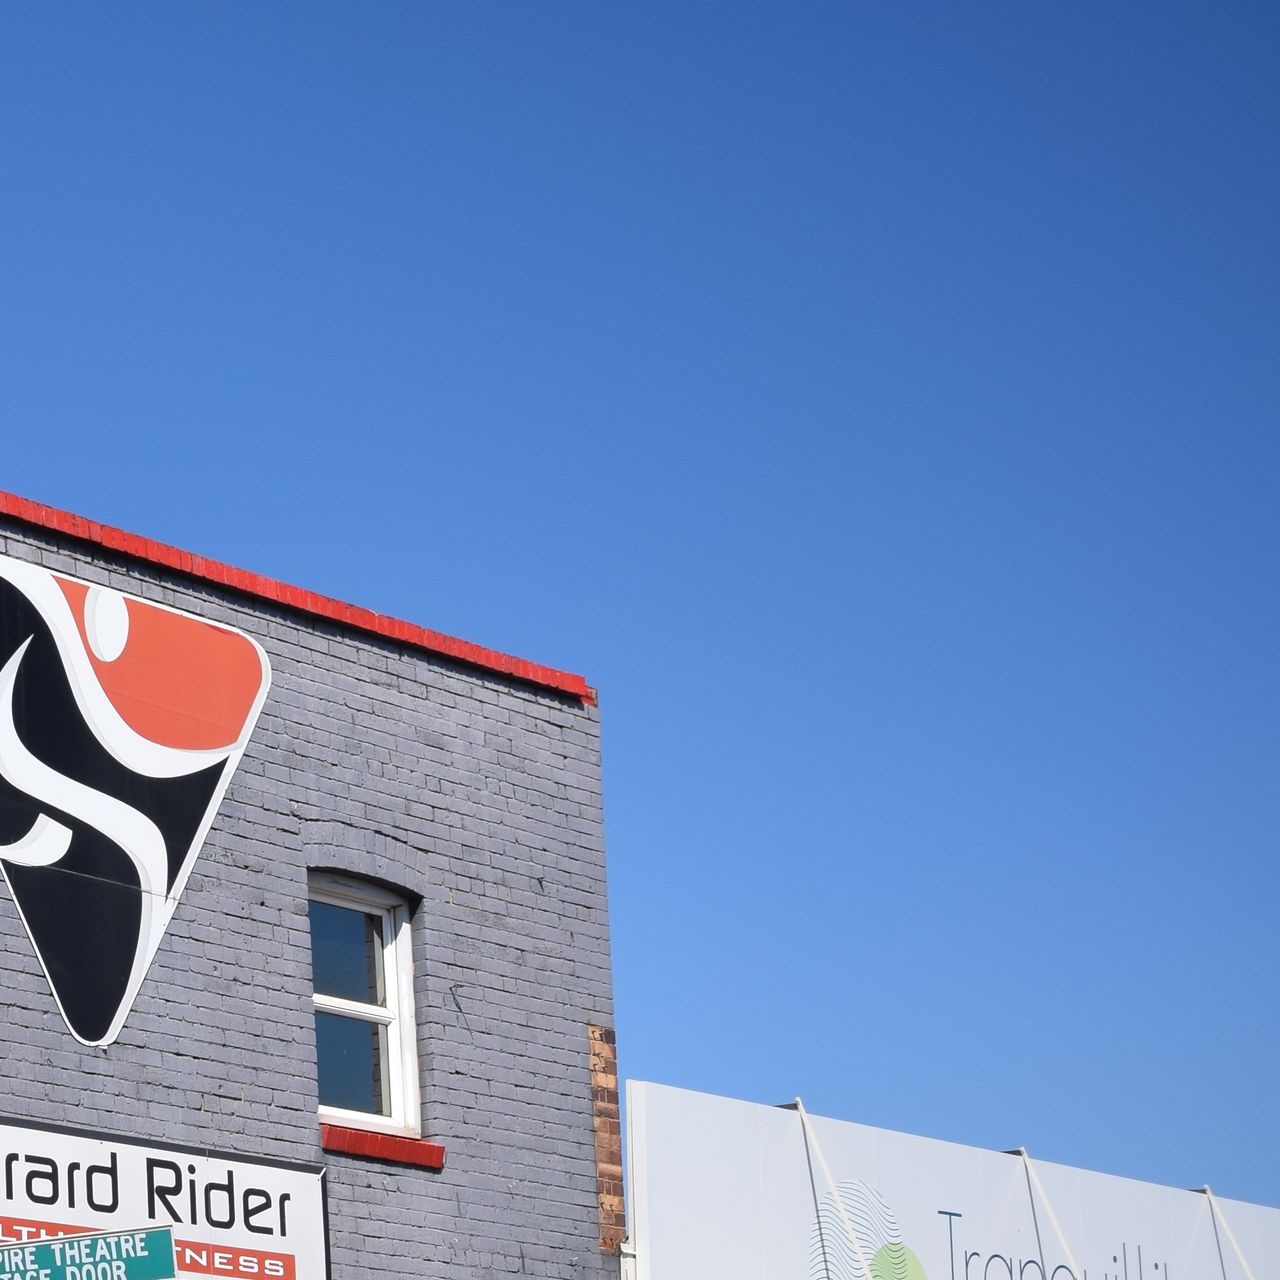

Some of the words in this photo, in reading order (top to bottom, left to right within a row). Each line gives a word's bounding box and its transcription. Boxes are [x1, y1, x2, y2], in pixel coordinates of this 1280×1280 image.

[145, 1156, 292, 1237] Rider
[53, 1231, 149, 1265] THEATRE
[175, 1246, 285, 1277] NESS
